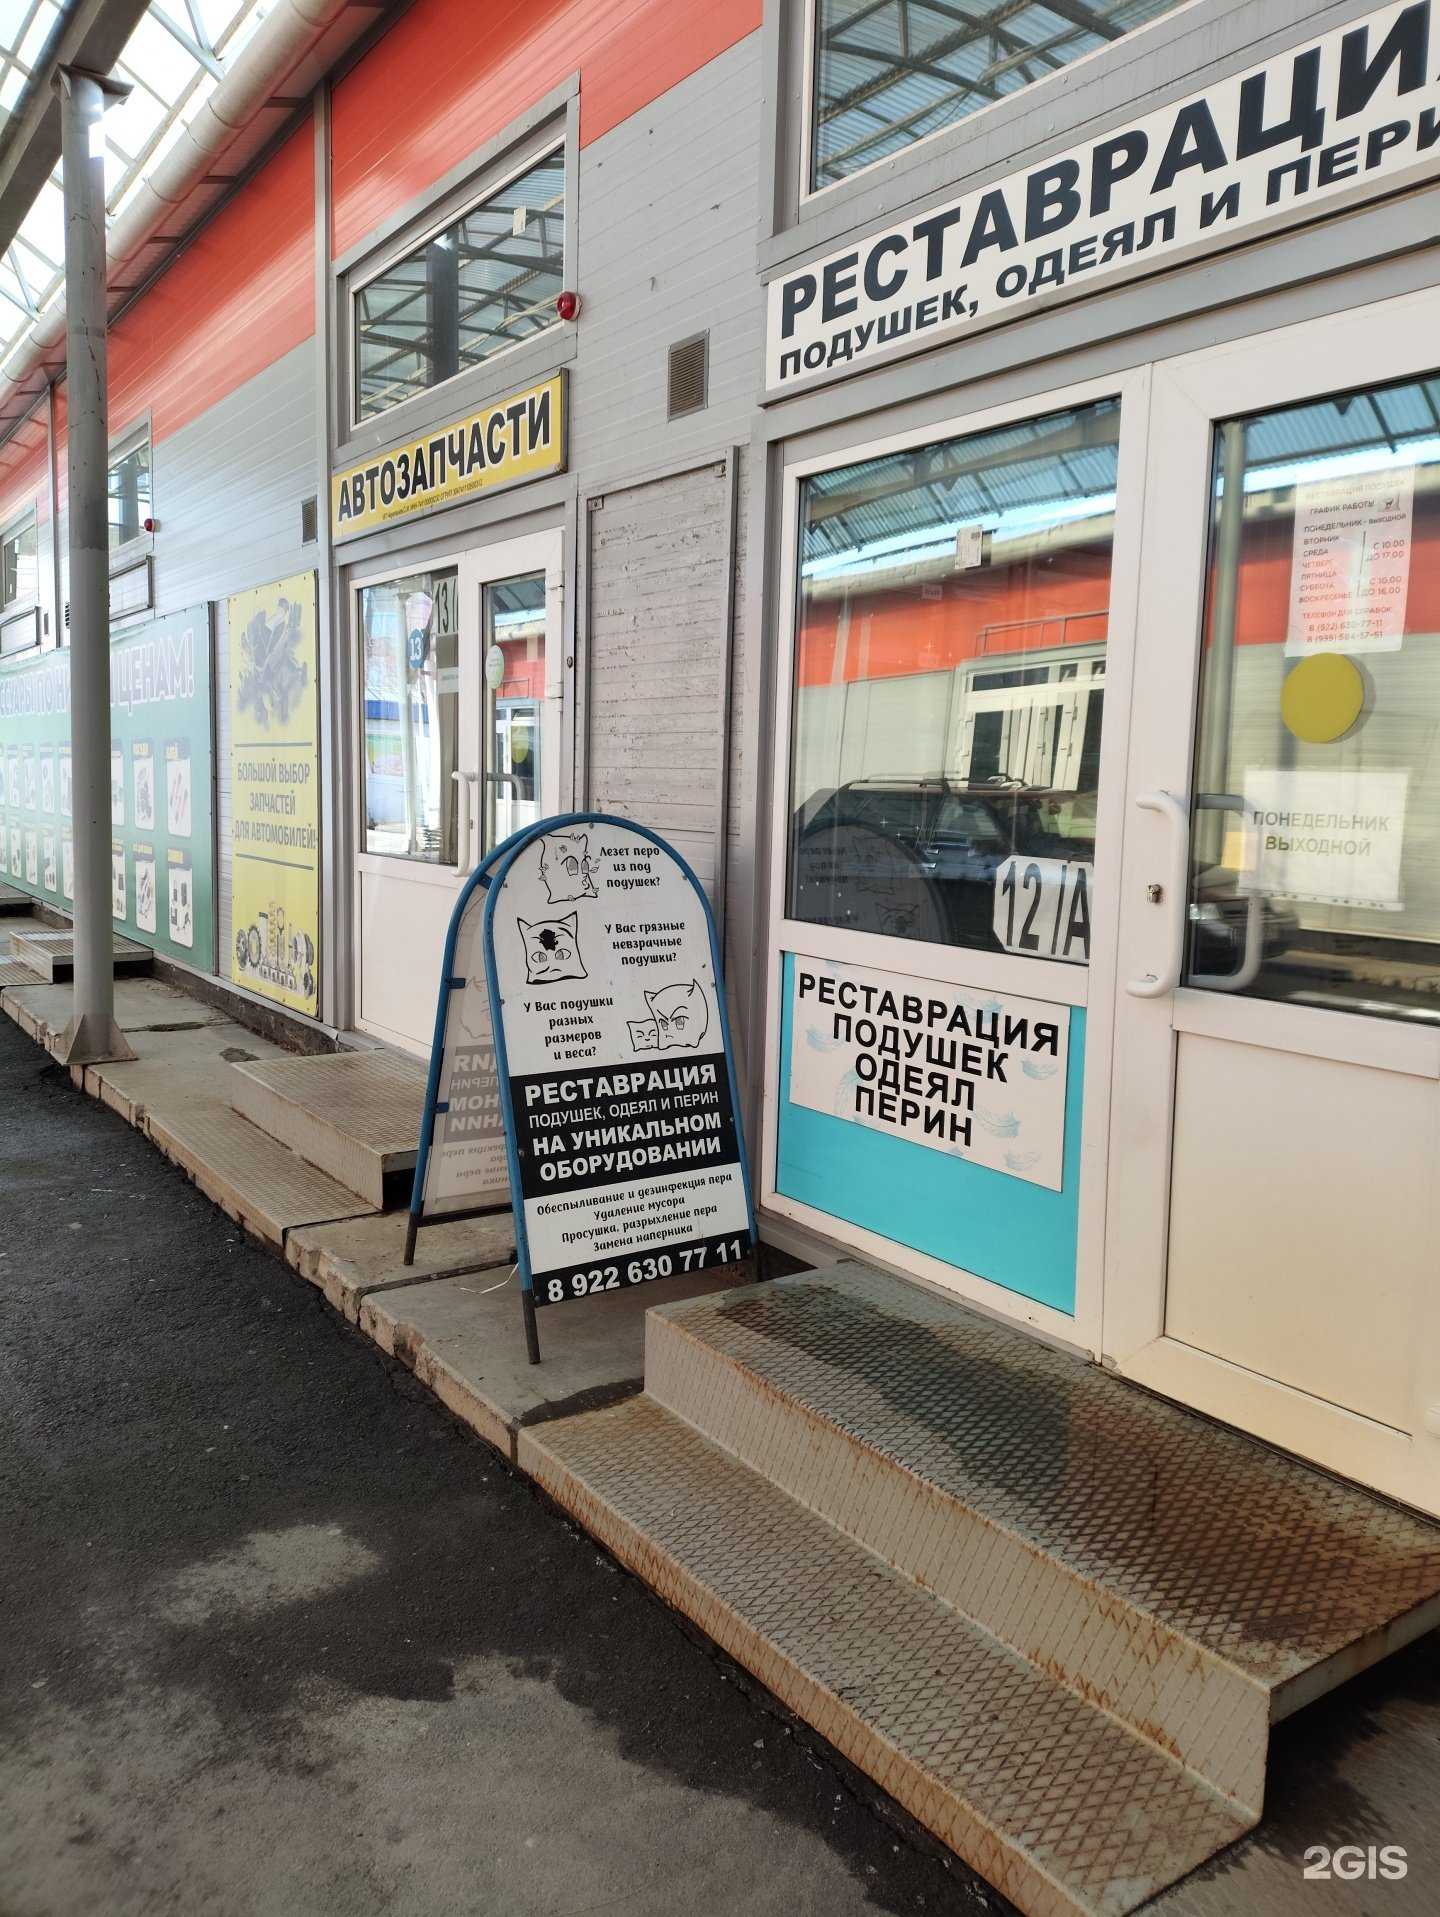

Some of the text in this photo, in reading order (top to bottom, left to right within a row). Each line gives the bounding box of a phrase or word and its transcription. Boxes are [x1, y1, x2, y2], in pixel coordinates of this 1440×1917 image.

[780, 0, 1440, 340] РЕСТАВРАЦИ
[779, 283, 980, 380] ПОДУШЕК,
[995, 206, 1176, 298] ОДЕЯЛ
[1199, 183, 1240, 229] И
[338, 390, 550, 522] АВТОЗАПЧАСТИ
[1310, 500, 1374, 515] ГРАФИК РАБОТЫ
[1304, 519, 1362, 533] ПОНЕДЕЛЬНИК
[1303, 535, 1339, 545] ВТОРНИК
[237, 758, 311, 785] БОЛЬШОЙ ВЫБОР
[249, 789, 296, 816] ЗАПЧАСТЕЙ
[234, 820, 250, 841] ДЛЯ
[1253, 811, 1391, 832] ПОНЕДЕЛЬНИК
[600, 846, 661, 859] Лезет перо
[1265, 835, 1372, 856] ВЫХОДНОЙ
[613, 863, 651, 874] из под
[606, 876, 660, 889] подушек?
[604, 921, 685, 934] У Вас грязные
[612, 937, 682, 951] невзрачные
[621, 952, 677, 967] подушки?
[523, 996, 614, 1013] У Вас подушки
[799, 972, 1059, 1057] РЕСТАВРАЦИЯ
[549, 1015, 594, 1029] разных
[544, 1030, 602, 1047] размеров
[833, 1013, 1009, 1083] ПОДУШЕК
[553, 1047, 597, 1061] и веса?
[524, 1063, 717, 1107] РЕСТАВРАЦИЯ
[855, 1052, 975, 1111] ОДЕЯЛ
[528, 1091, 719, 1129] ПОДУШЕК, ОДЕЯЛ И ПЕРИН
[855, 1085, 972, 1147] ПЕРИН
[532, 1111, 722, 1156] НА УНИКАЛЬНОМ
[540, 1136, 721, 1182] ОБОРУДОВАНИИ
[536, 1173, 733, 1216] Обеспыливание и дезинфекция пера
[593, 1195, 685, 1222] Удаление мусора
[622, 1209, 691, 1235] разрыхление
[693, 1204, 718, 1219] пера
[593, 1223, 693, 1252] Замена наперника
[547, 1239, 743, 1302] 8 922 630 77 11
